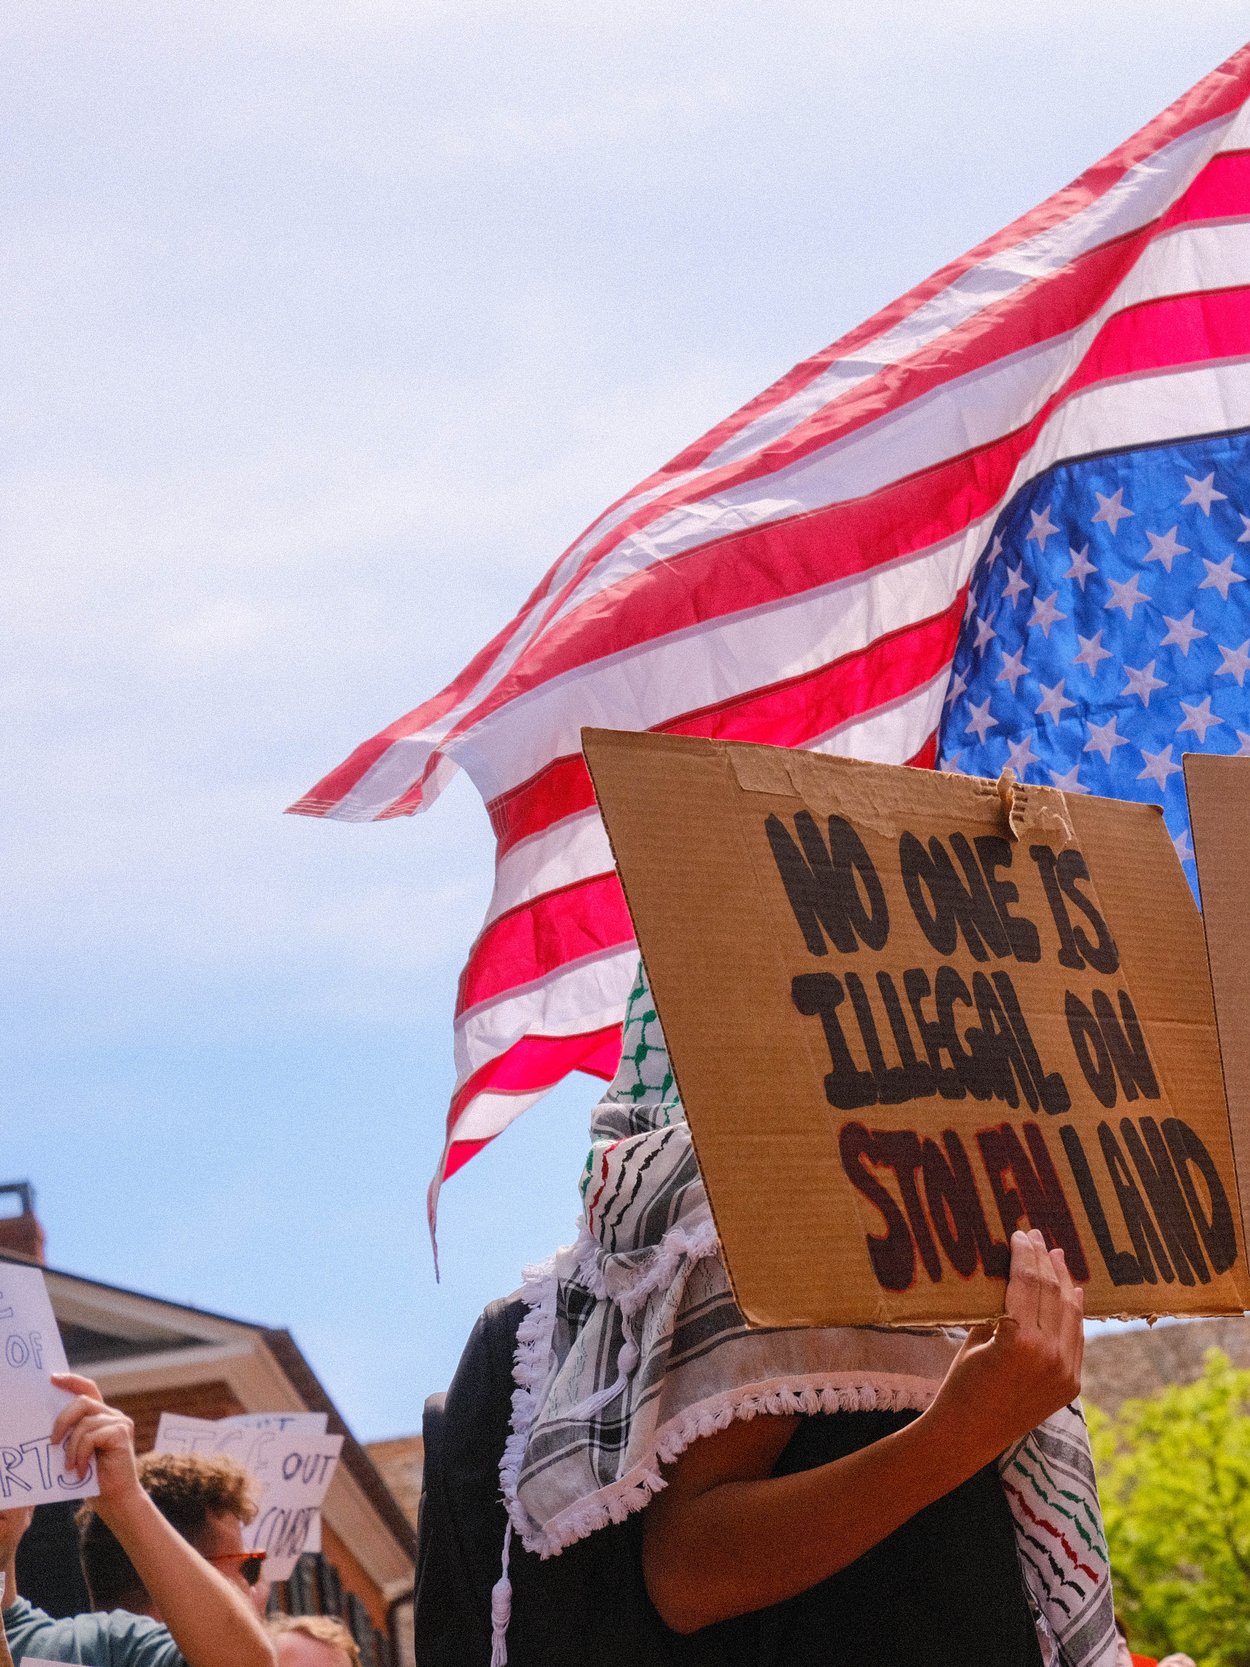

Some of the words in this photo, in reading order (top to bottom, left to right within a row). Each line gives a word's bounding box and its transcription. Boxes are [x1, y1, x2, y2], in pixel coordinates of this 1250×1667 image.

[764, 809, 891, 957] NO
[899, 830, 1042, 963] ONE
[1029, 844, 1121, 974] IS
[790, 965, 1072, 1115] ILLEGAL
[1063, 988, 1163, 1109] ON
[838, 1120, 1091, 1292] STOLEN
[1059, 1115, 1239, 1287] LAND
[5, 1330, 43, 1370] OF
[282, 1452, 337, 1485] OUT
